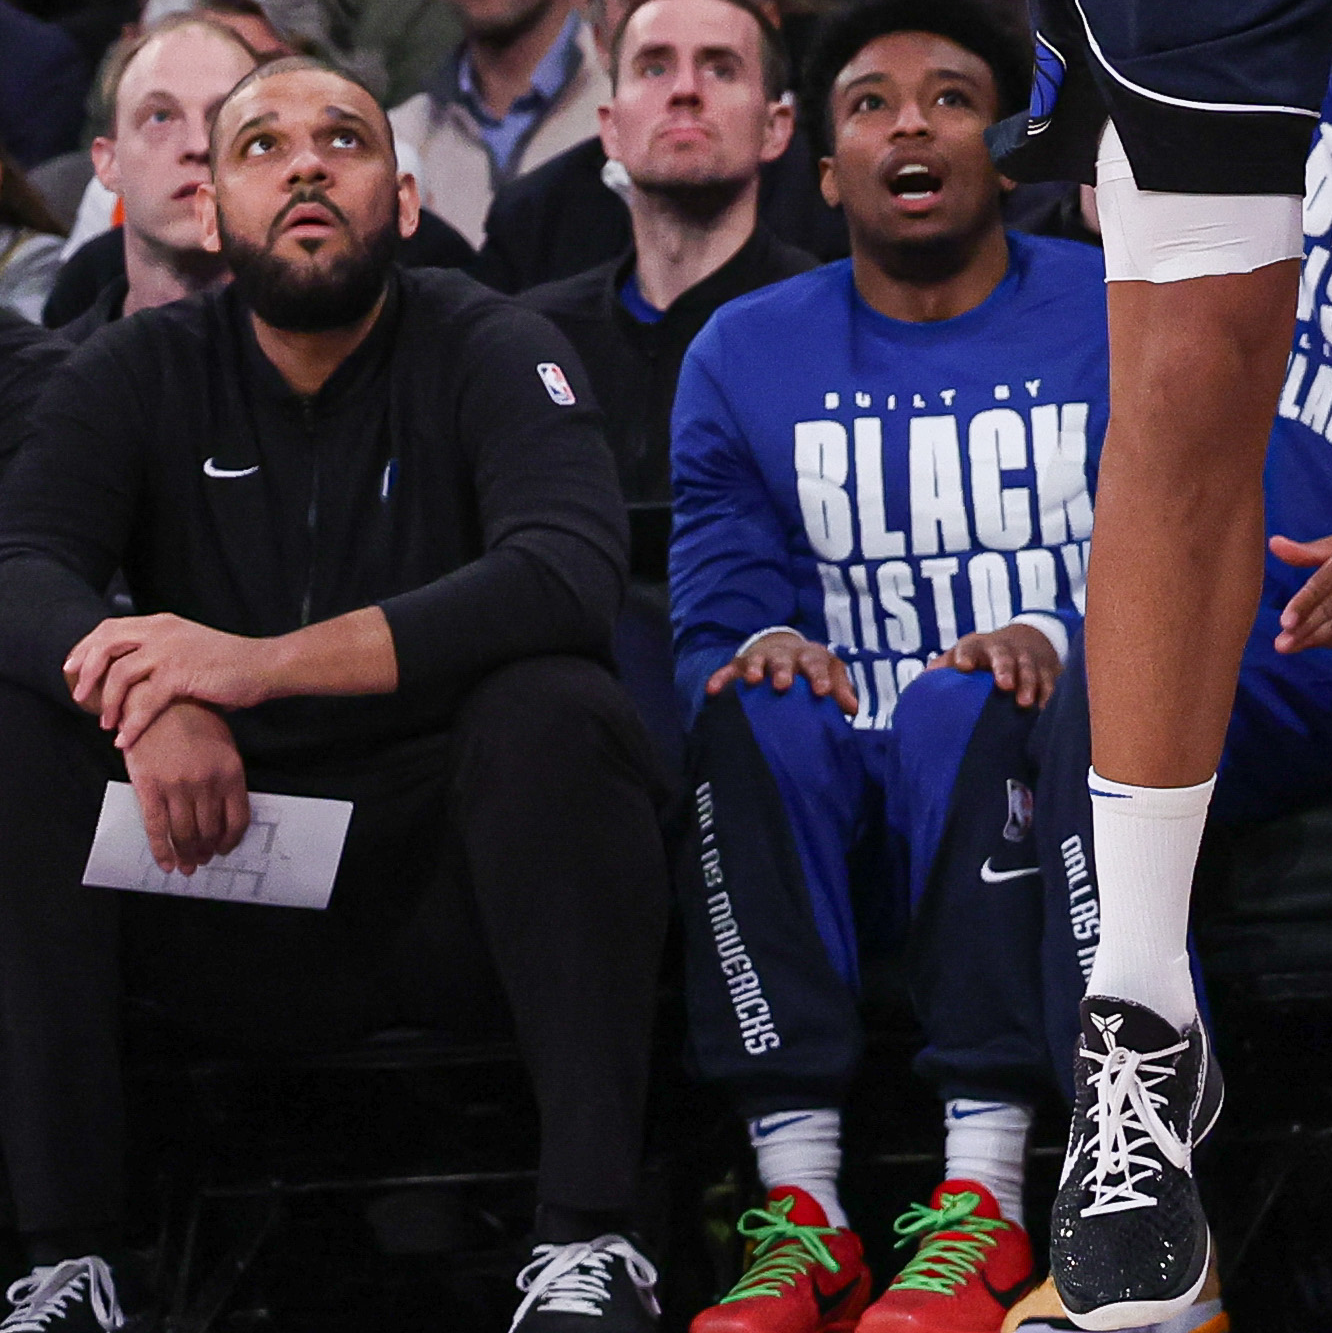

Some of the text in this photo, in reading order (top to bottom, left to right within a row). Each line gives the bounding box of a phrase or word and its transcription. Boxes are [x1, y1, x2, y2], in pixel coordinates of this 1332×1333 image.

[824, 378, 1042, 411] BUILT BY
[793, 401, 1095, 562] BLACK
[1060, 833, 1101, 941] DALLAS
[706, 890, 782, 1056] MAVERICKS
